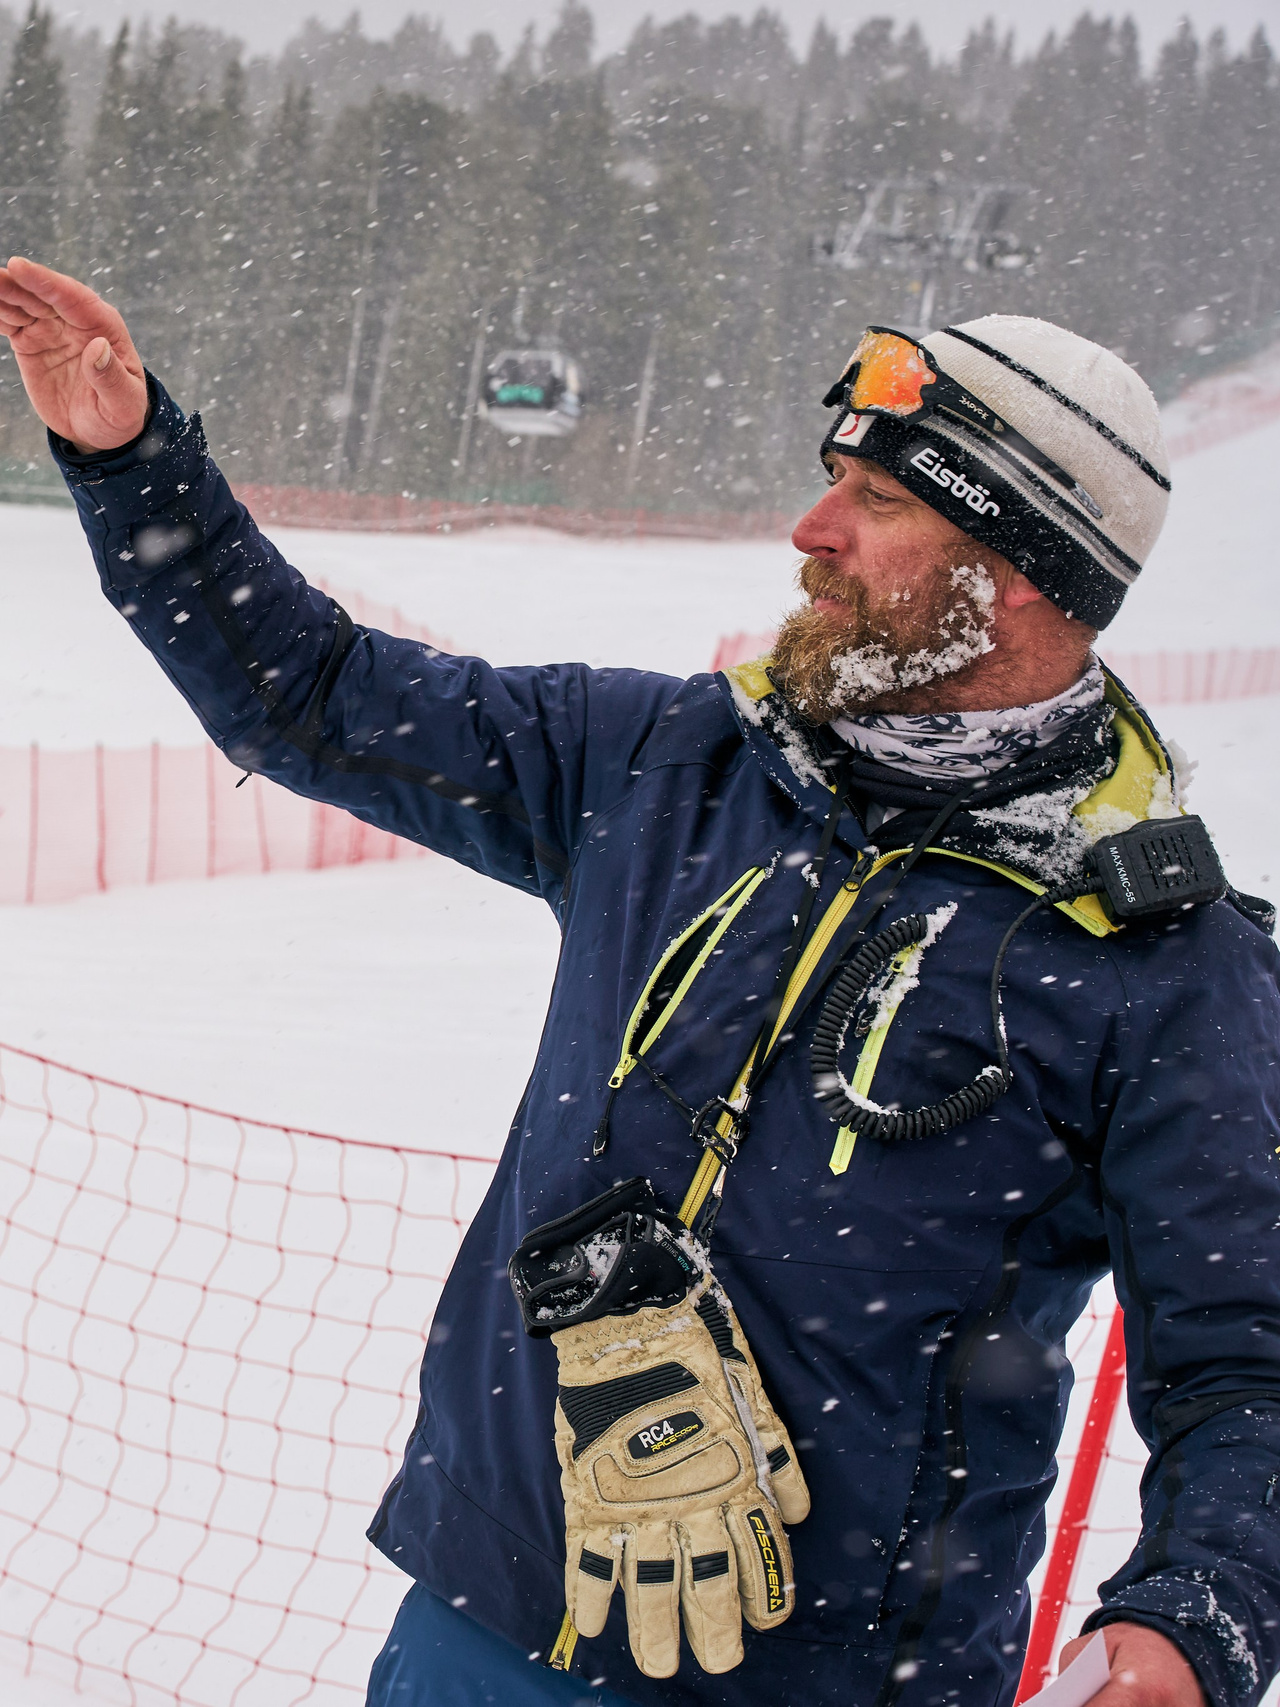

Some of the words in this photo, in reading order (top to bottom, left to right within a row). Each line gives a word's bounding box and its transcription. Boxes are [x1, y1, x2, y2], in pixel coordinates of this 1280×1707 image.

[910, 447, 1001, 517] Eisbär
[661, 1241, 679, 1258] SHIELD
[677, 1255, 690, 1271] AQUA
[638, 1420, 674, 1448] RC4
[750, 1516, 780, 1597] FISCHER
